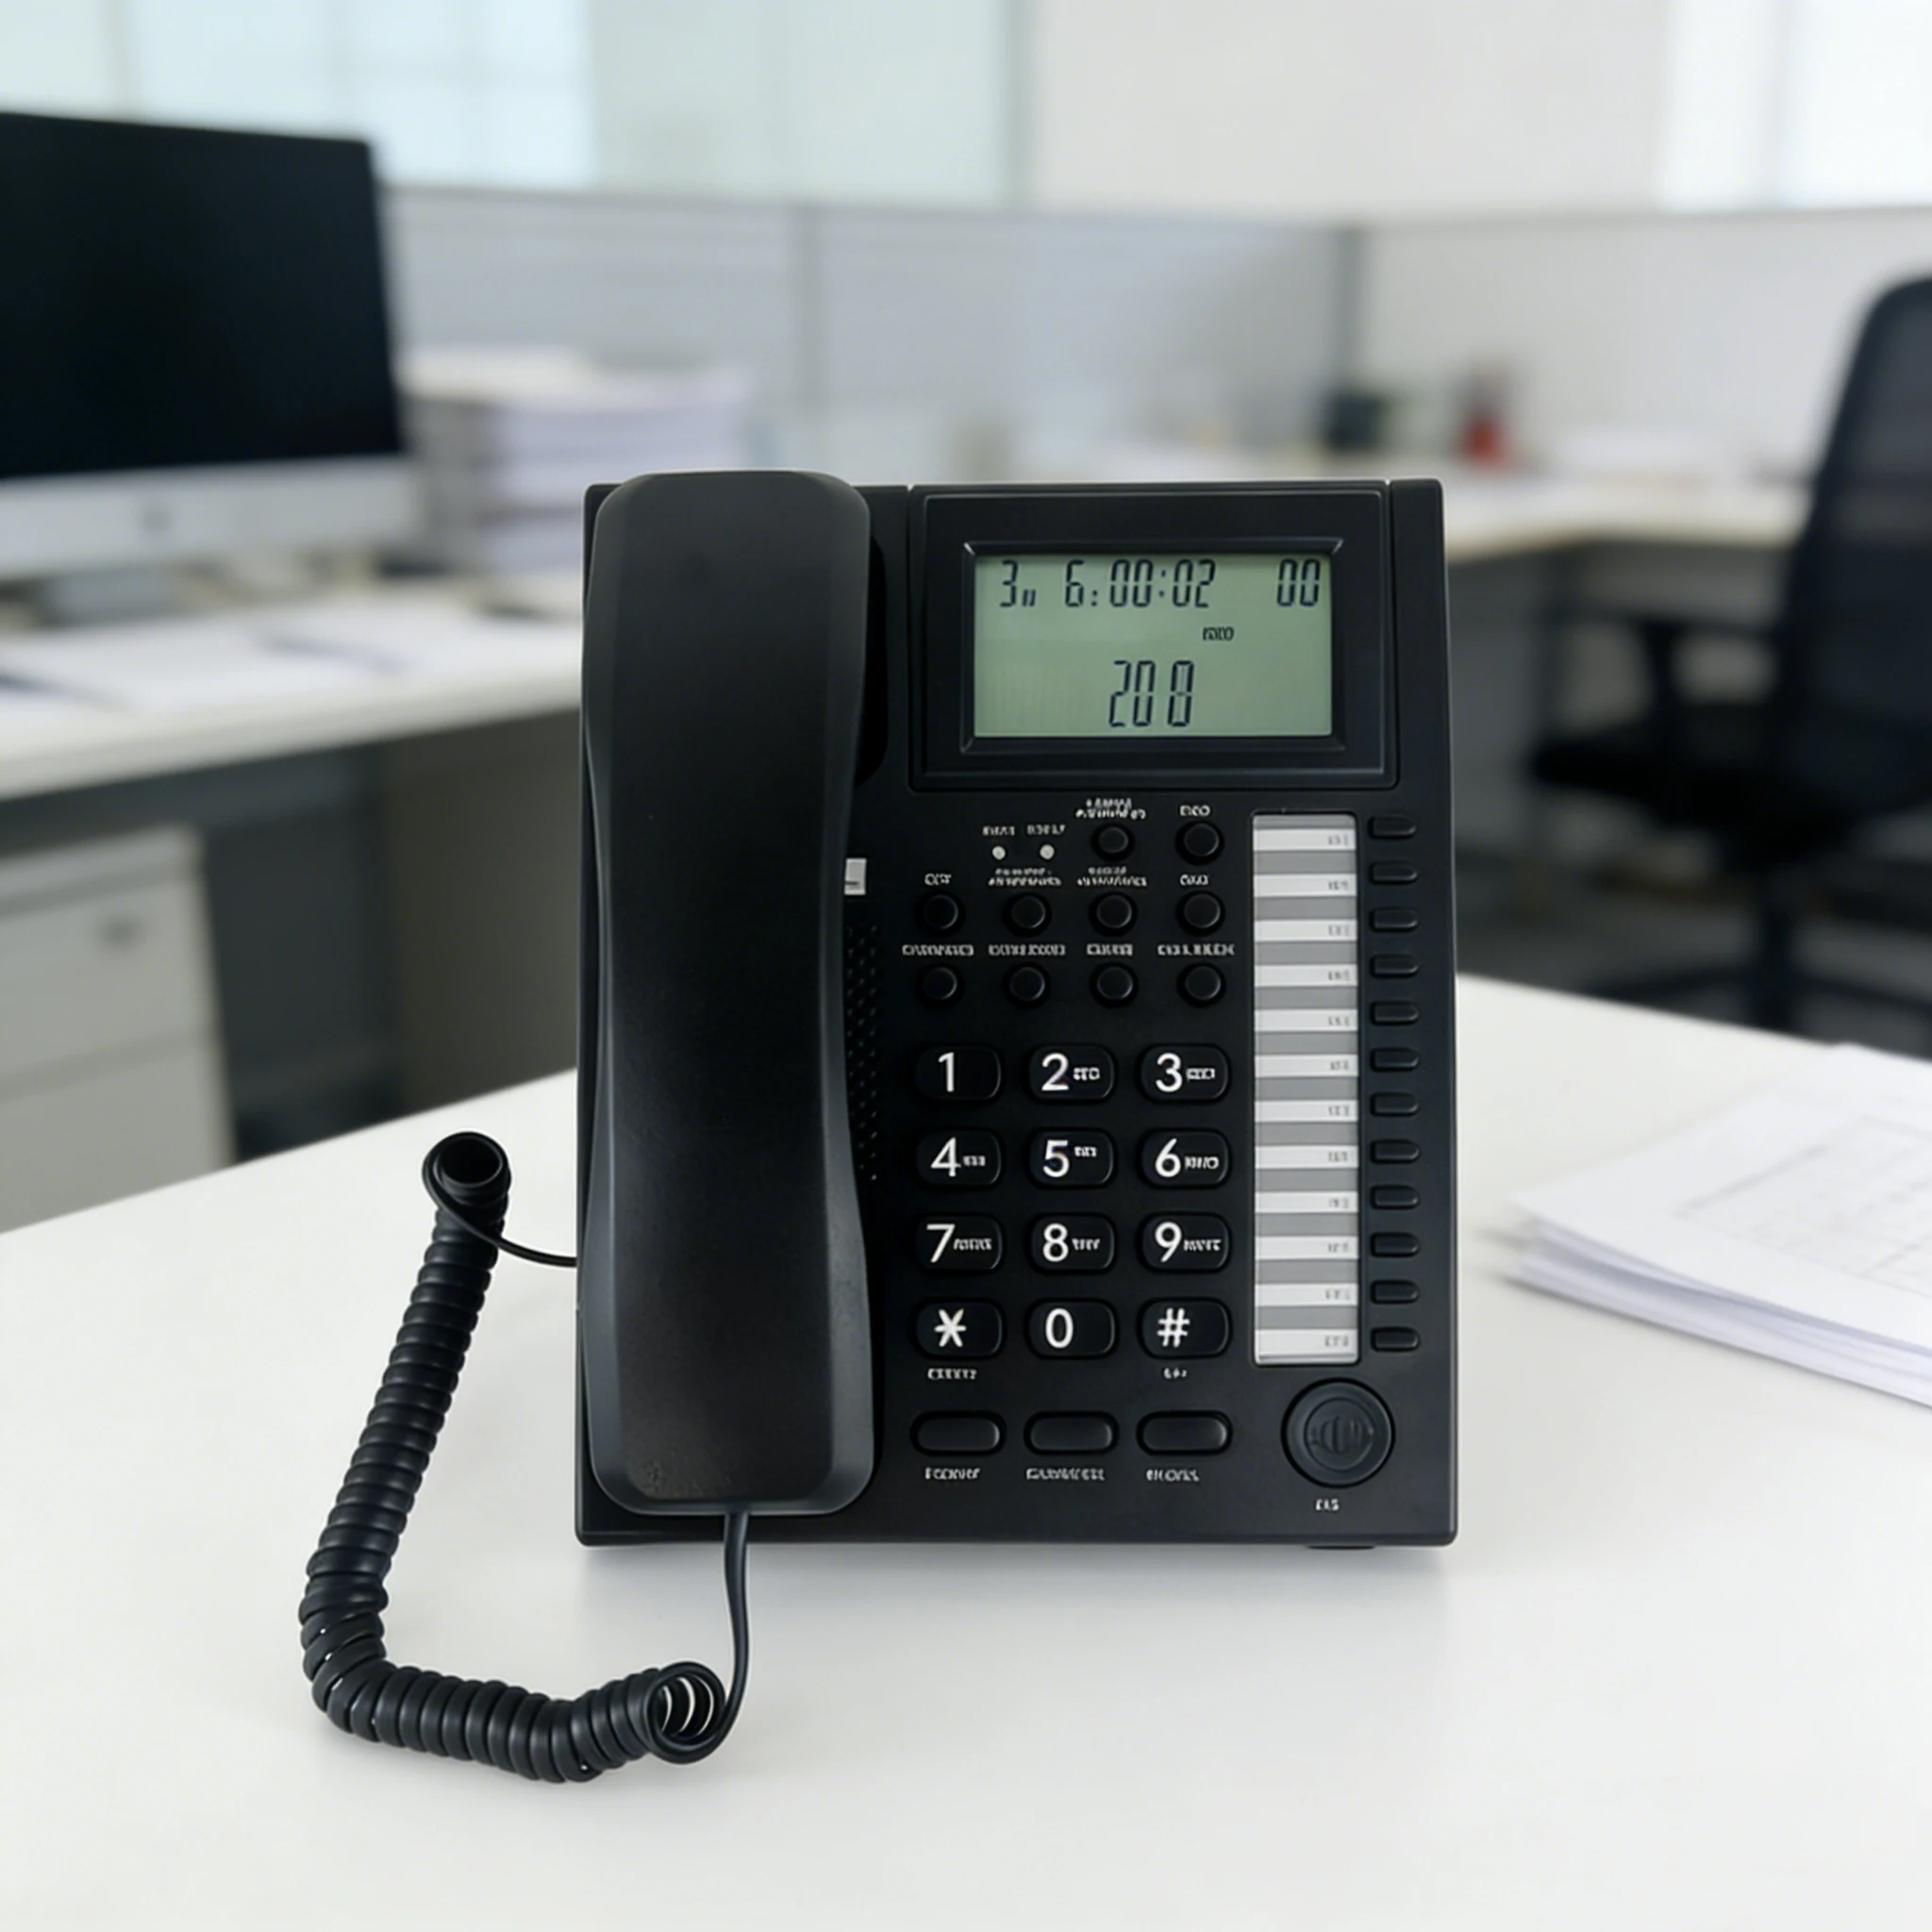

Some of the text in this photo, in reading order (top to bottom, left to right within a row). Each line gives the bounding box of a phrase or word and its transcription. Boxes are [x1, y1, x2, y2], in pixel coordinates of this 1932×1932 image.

[1276, 559, 1321, 608] 00
[939, 1052, 955, 1092] 1
[1041, 1052, 1070, 1091] 2
[1155, 1052, 1183, 1092] 3
[930, 1137, 961, 1177] 4
[1042, 1139, 1070, 1178] 5
[1155, 1138, 1182, 1178] 6
[926, 1224, 956, 1263] 7
[1042, 1223, 1069, 1262] 8
[1155, 1221, 1182, 1263] 9
[1045, 1307, 1074, 1349] 0
